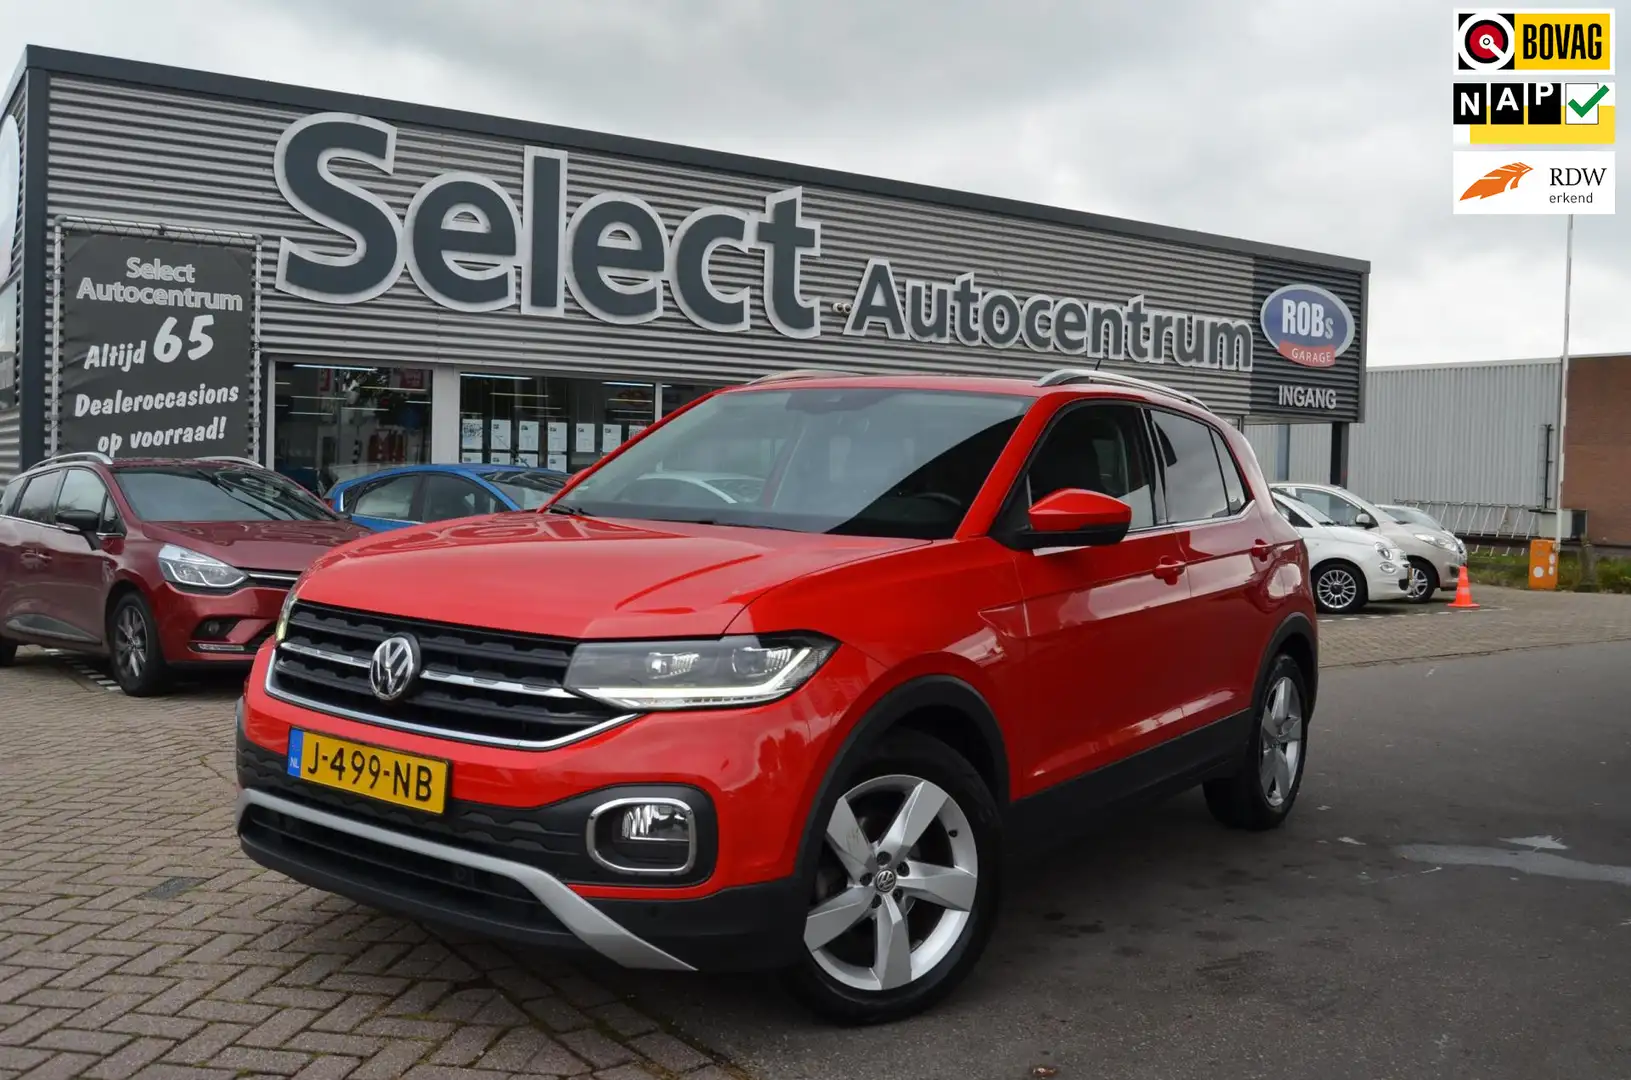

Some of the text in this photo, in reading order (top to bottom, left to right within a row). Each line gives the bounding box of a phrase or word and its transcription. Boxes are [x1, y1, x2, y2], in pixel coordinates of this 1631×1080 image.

[274, 111, 1253, 372] Select Autocentrum
[126, 256, 196, 284] Select
[76, 277, 243, 311] Autocentrum
[84, 314, 215, 372] Altijd 65
[1291, 347, 1332, 364] GARAGE
[74, 384, 239, 418] Dealeroccasions
[1278, 385, 1337, 409] INGANG
[97, 416, 227, 457] op voorraad!
[289, 757, 300, 769] NL
[307, 741, 432, 802] J-499-NB
